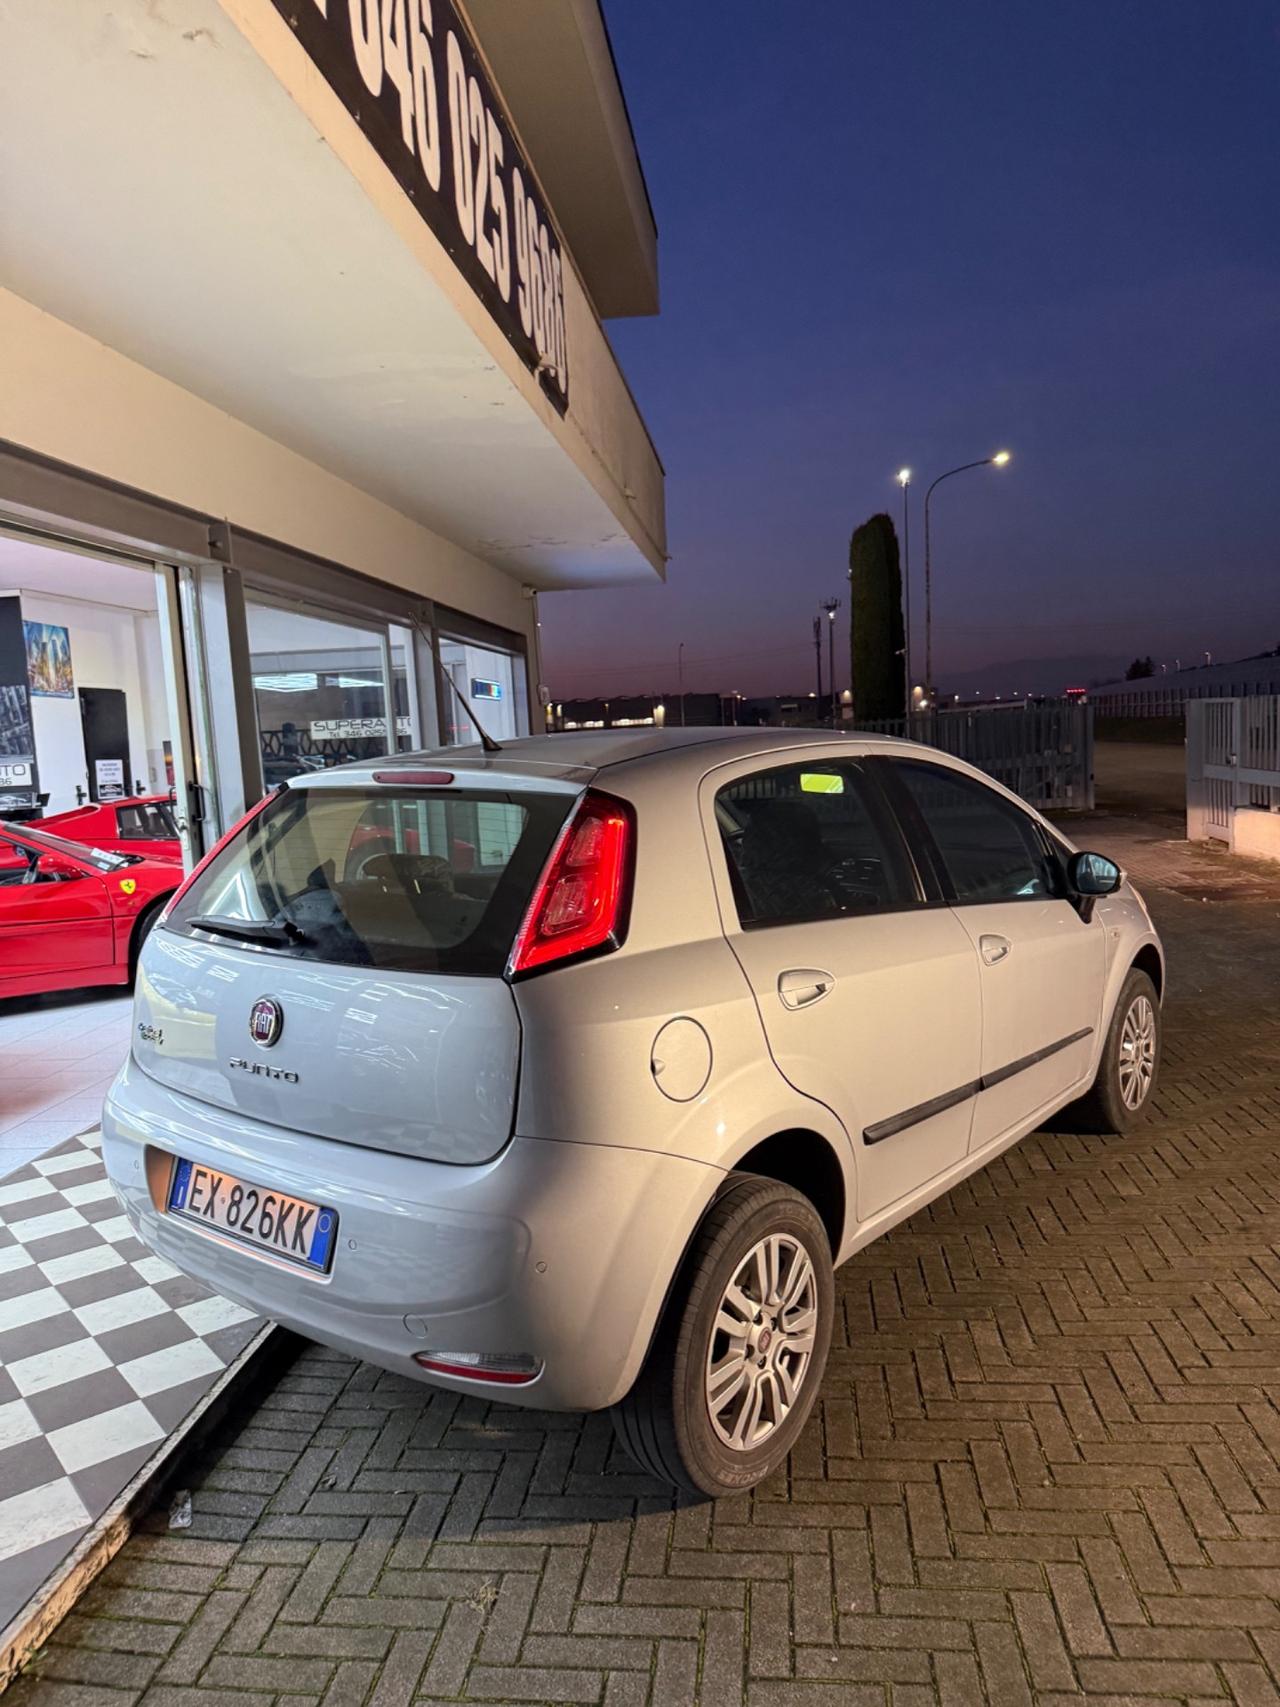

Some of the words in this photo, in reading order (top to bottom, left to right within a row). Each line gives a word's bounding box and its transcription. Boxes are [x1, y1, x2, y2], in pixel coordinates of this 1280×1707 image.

[447, 30, 510, 303] 025
[314, 717, 411, 731] SUPERAT
[229, 1056, 299, 1083] PUNTO
